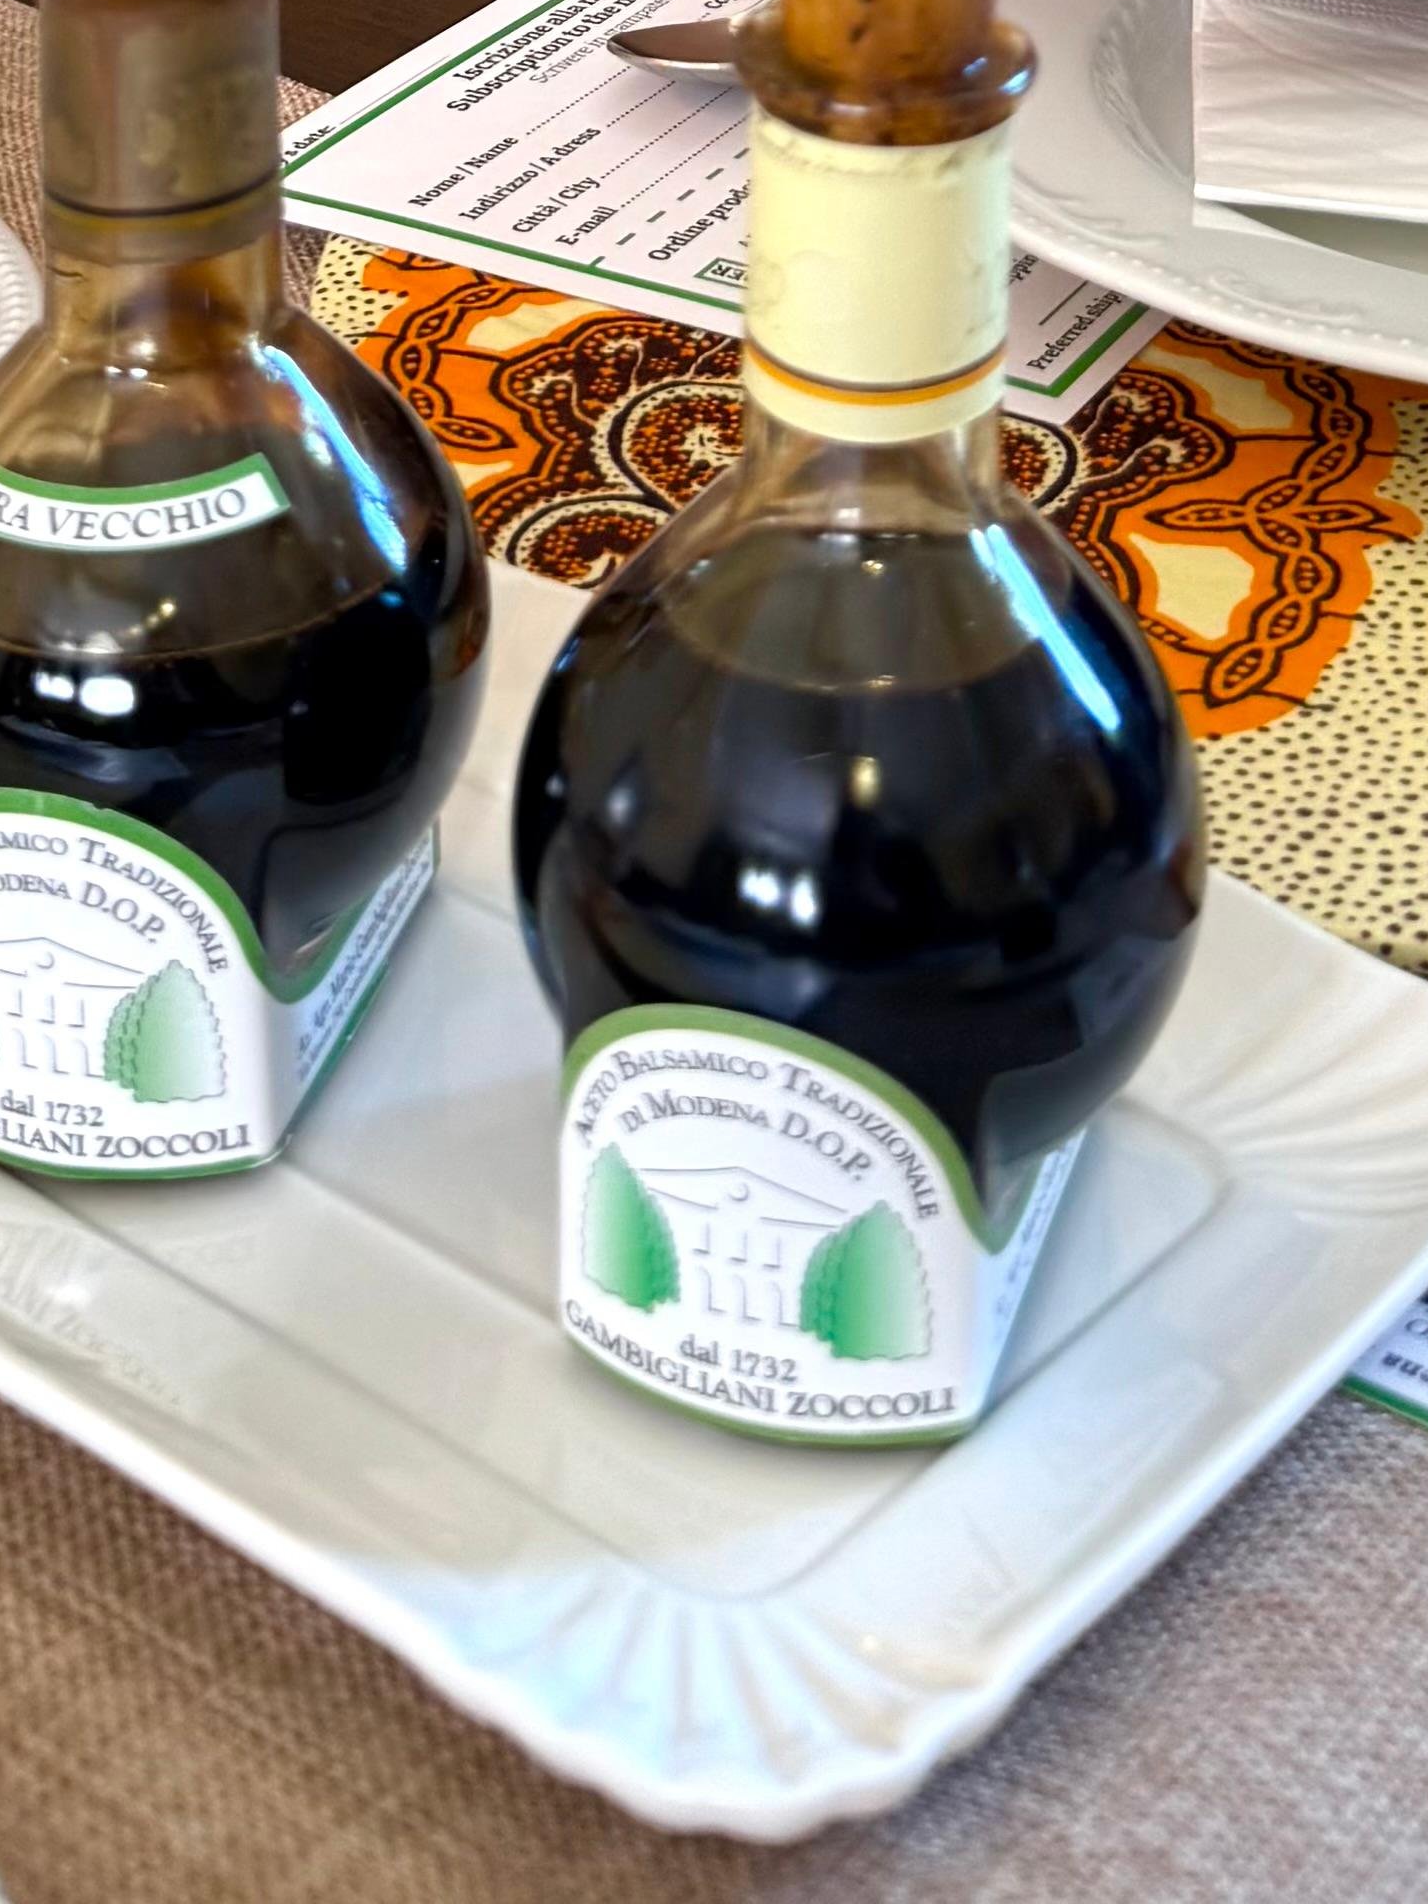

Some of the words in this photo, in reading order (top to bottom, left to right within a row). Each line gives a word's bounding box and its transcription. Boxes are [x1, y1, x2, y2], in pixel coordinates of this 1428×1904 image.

[446, 37, 574, 113] Subscription
[562, 22, 592, 38] to
[582, 3, 622, 25] the
[452, 23, 554, 83] Iscrizione
[548, 3, 588, 26] alla
[407, 166, 464, 209] Nome
[473, 135, 520, 171] Name
[459, 166, 539, 222] Indirizzo
[511, 200, 562, 235] Città
[558, 173, 602, 202] City
[555, 205, 620, 249] E-mail
[647, 217, 715, 262] Ordine
[1026, 315, 1093, 371] Preferred
[1085, 289, 1123, 320] ship
[47, 487, 247, 541] VECCHIO
[79, 880, 166, 945] D.O.P.
[0, 1088, 36, 1118] dal
[43, 1100, 106, 1128] 1732
[96, 1123, 253, 1159] ZOCCOLI
[778, 1108, 878, 1184] D.O.P.
[563, 1296, 779, 1413] GAMBIGLIANI
[786, 1386, 959, 1423] ZOCCOLI
[678, 1333, 722, 1369] dal
[731, 1347, 800, 1383] 1732
